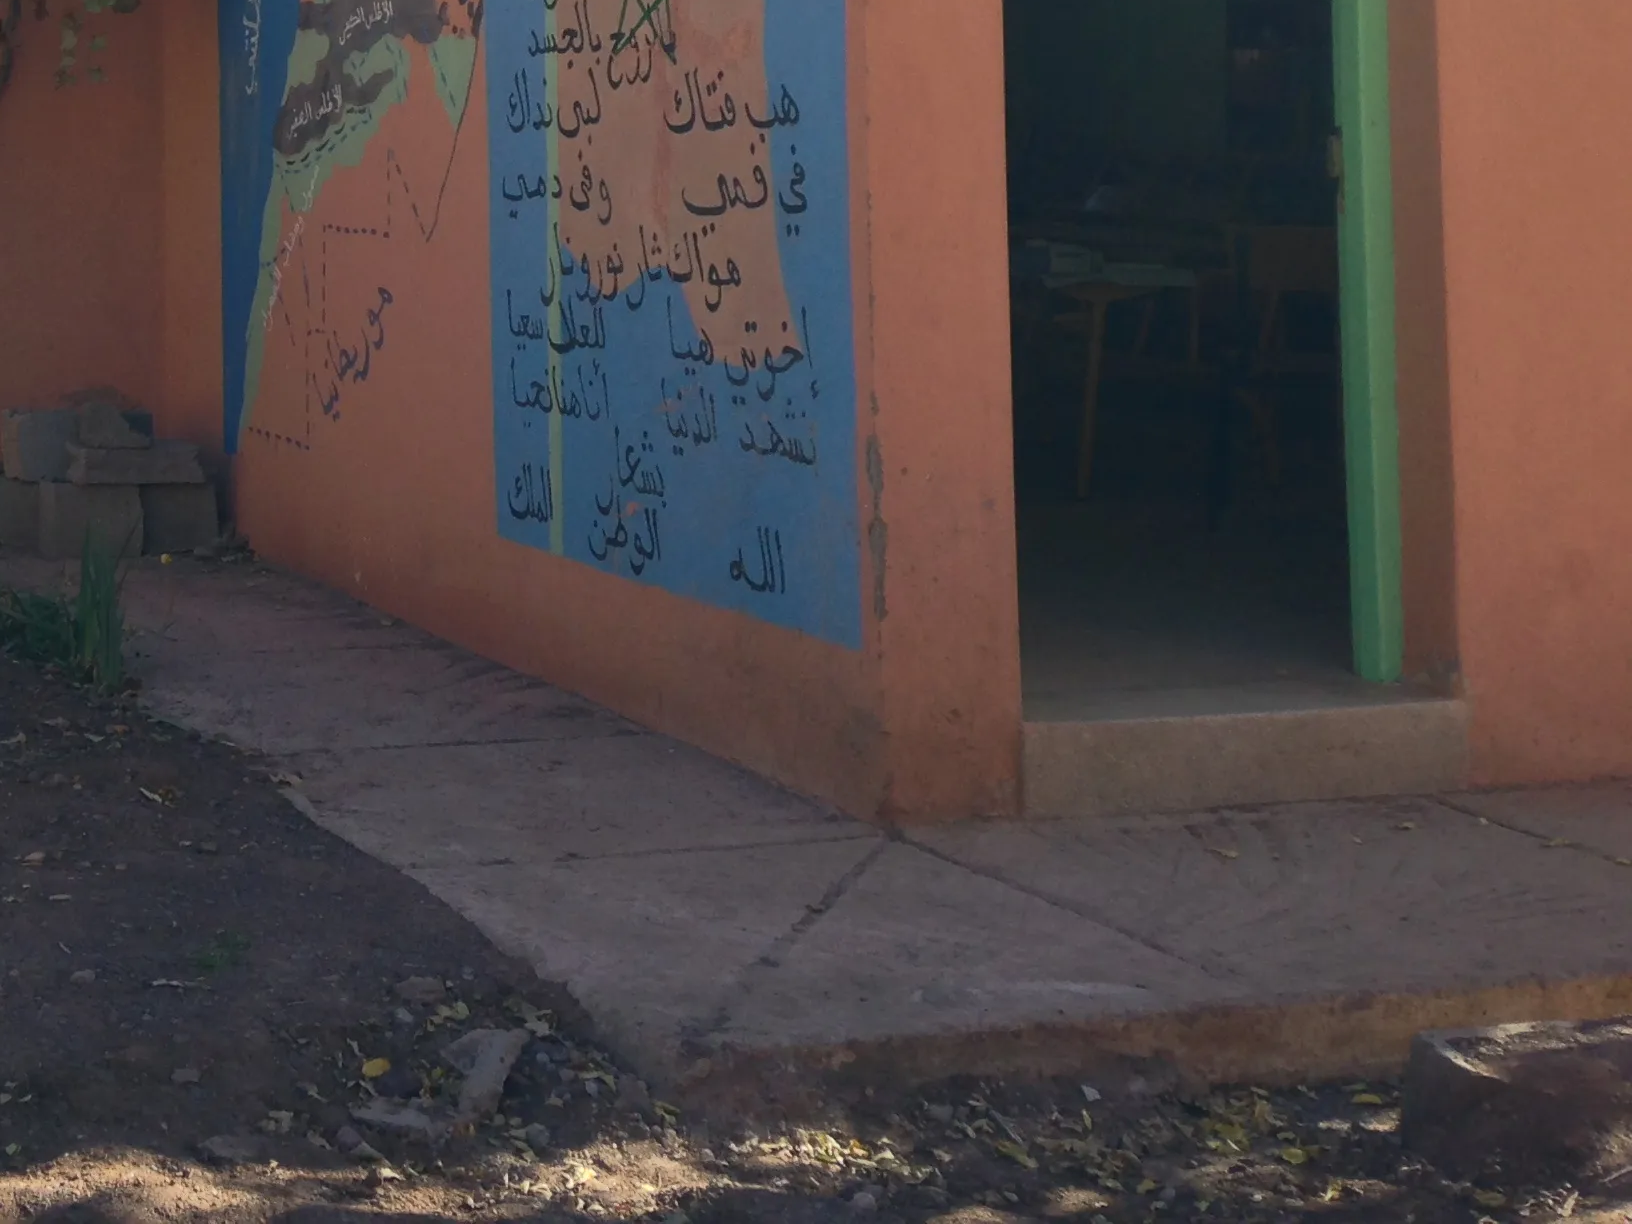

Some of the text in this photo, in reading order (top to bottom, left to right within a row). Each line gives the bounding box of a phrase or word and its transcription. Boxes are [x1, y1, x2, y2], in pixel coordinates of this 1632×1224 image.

[527, 0, 602, 69] بالجسد
[506, 66, 554, 134] نداك
[663, 66, 737, 135] فتاك
[744, 83, 801, 144] هب
[502, 173, 563, 220] دمي
[681, 142, 769, 237] فمي
[779, 143, 808, 237] في
[625, 224, 664, 312] ثار
[665, 231, 742, 313] هواك
[506, 288, 544, 351] سعيا
[666, 295, 716, 375] هيا
[510, 356, 554, 429] نحيا
[551, 365, 583, 420] هنا
[577, 357, 611, 422] أنا
[660, 376, 718, 457] الدنيا
[594, 424, 667, 516] بشعار
[507, 463, 786, 595] الله الوطن الملك
